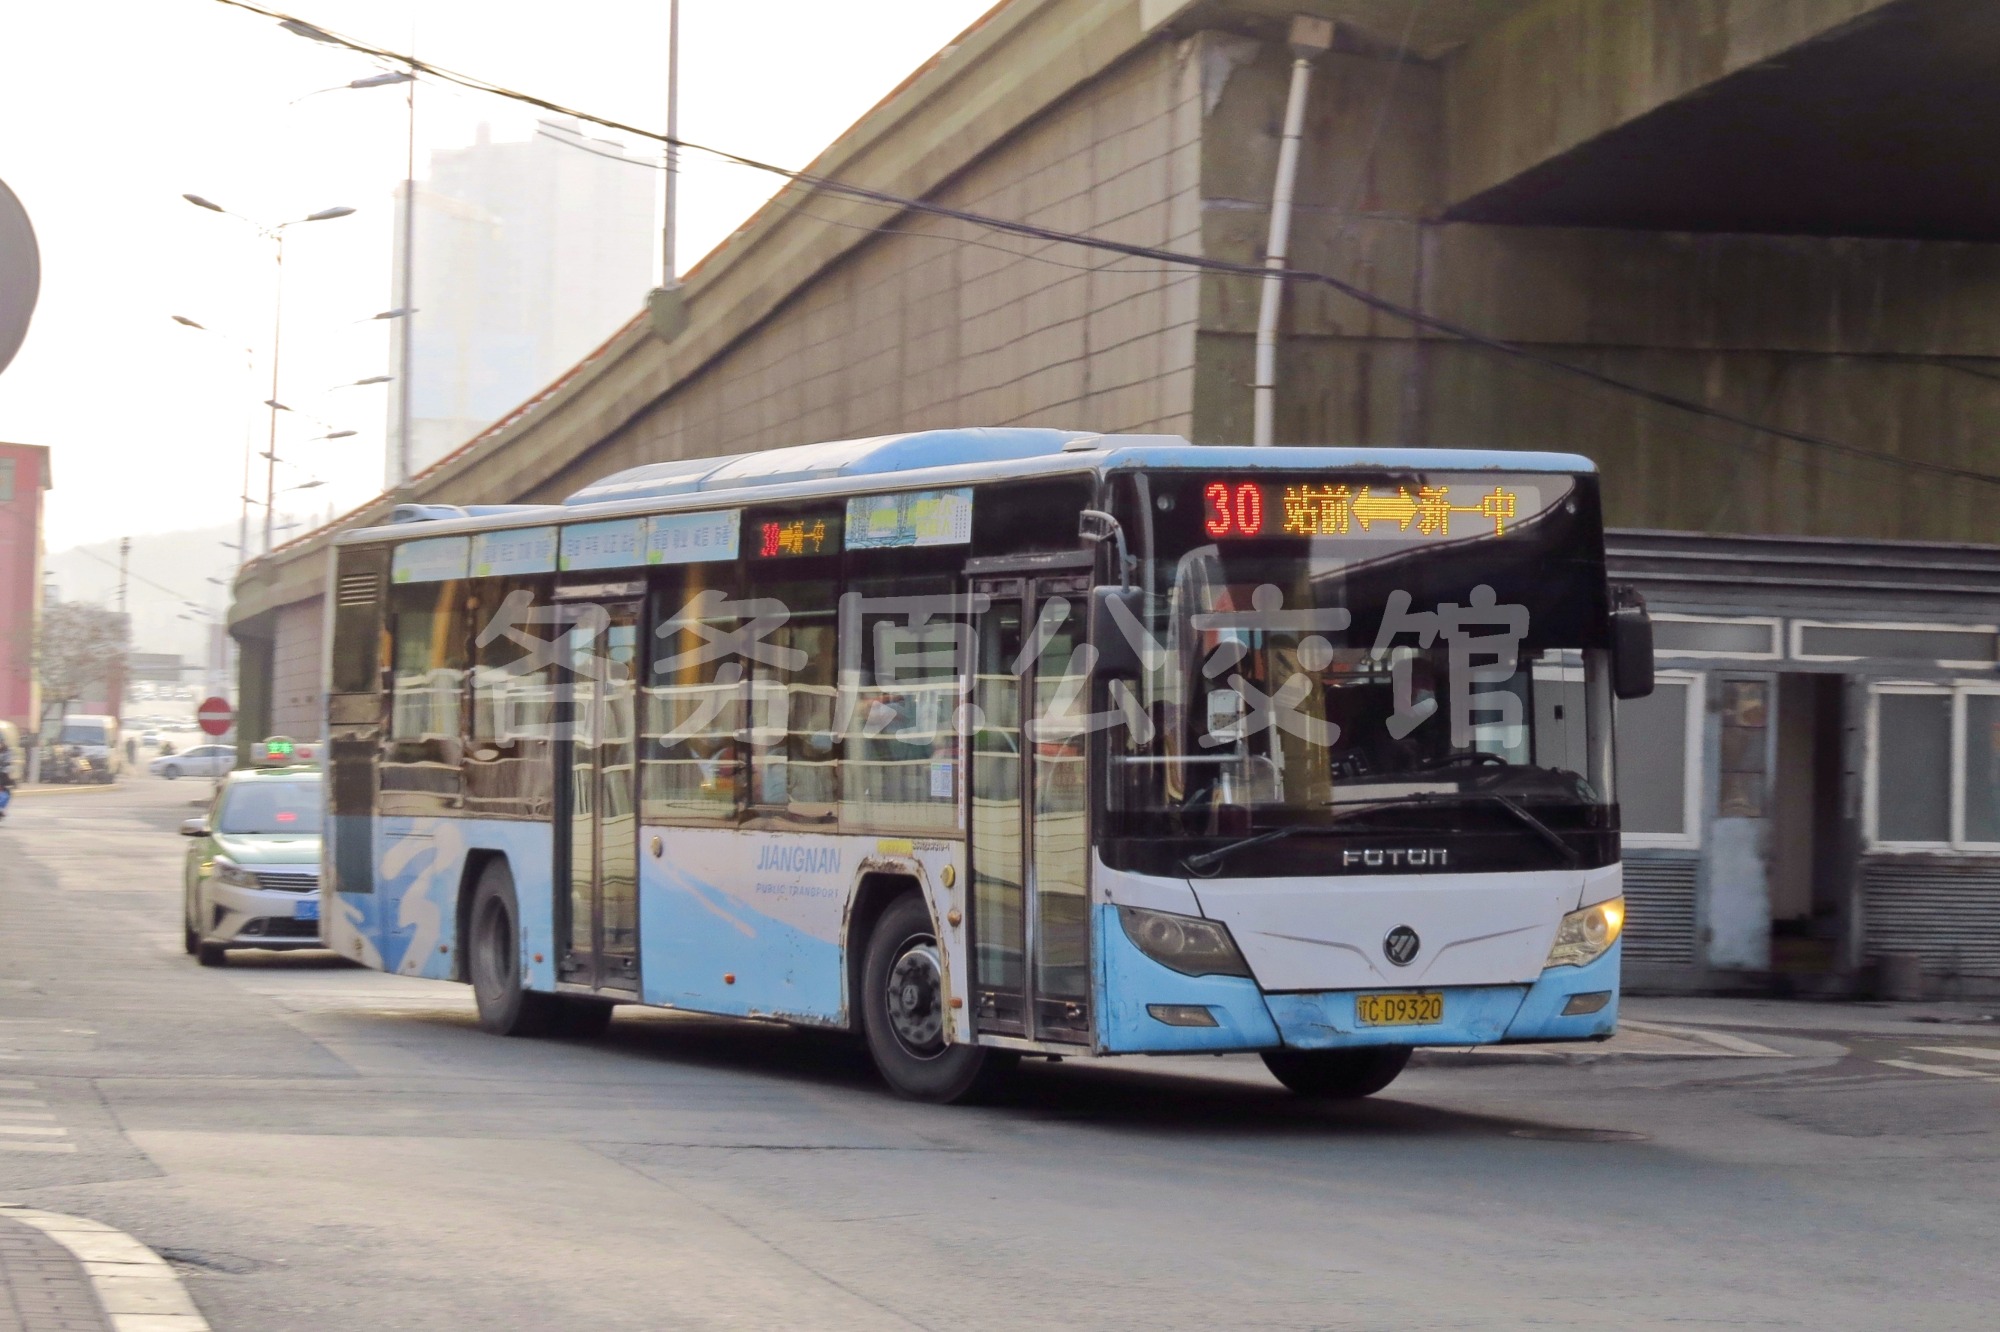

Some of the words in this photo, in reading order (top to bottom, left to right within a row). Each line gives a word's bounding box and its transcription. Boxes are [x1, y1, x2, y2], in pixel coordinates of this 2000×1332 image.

[1206, 484, 1261, 534] 30
[1283, 485, 1351, 534] 站前
[757, 844, 841, 874] JIANGNAN
[1343, 848, 1447, 866] FOTON
[756, 882, 786, 894] PUBLIC
[789, 885, 839, 898] TRANSPORT
